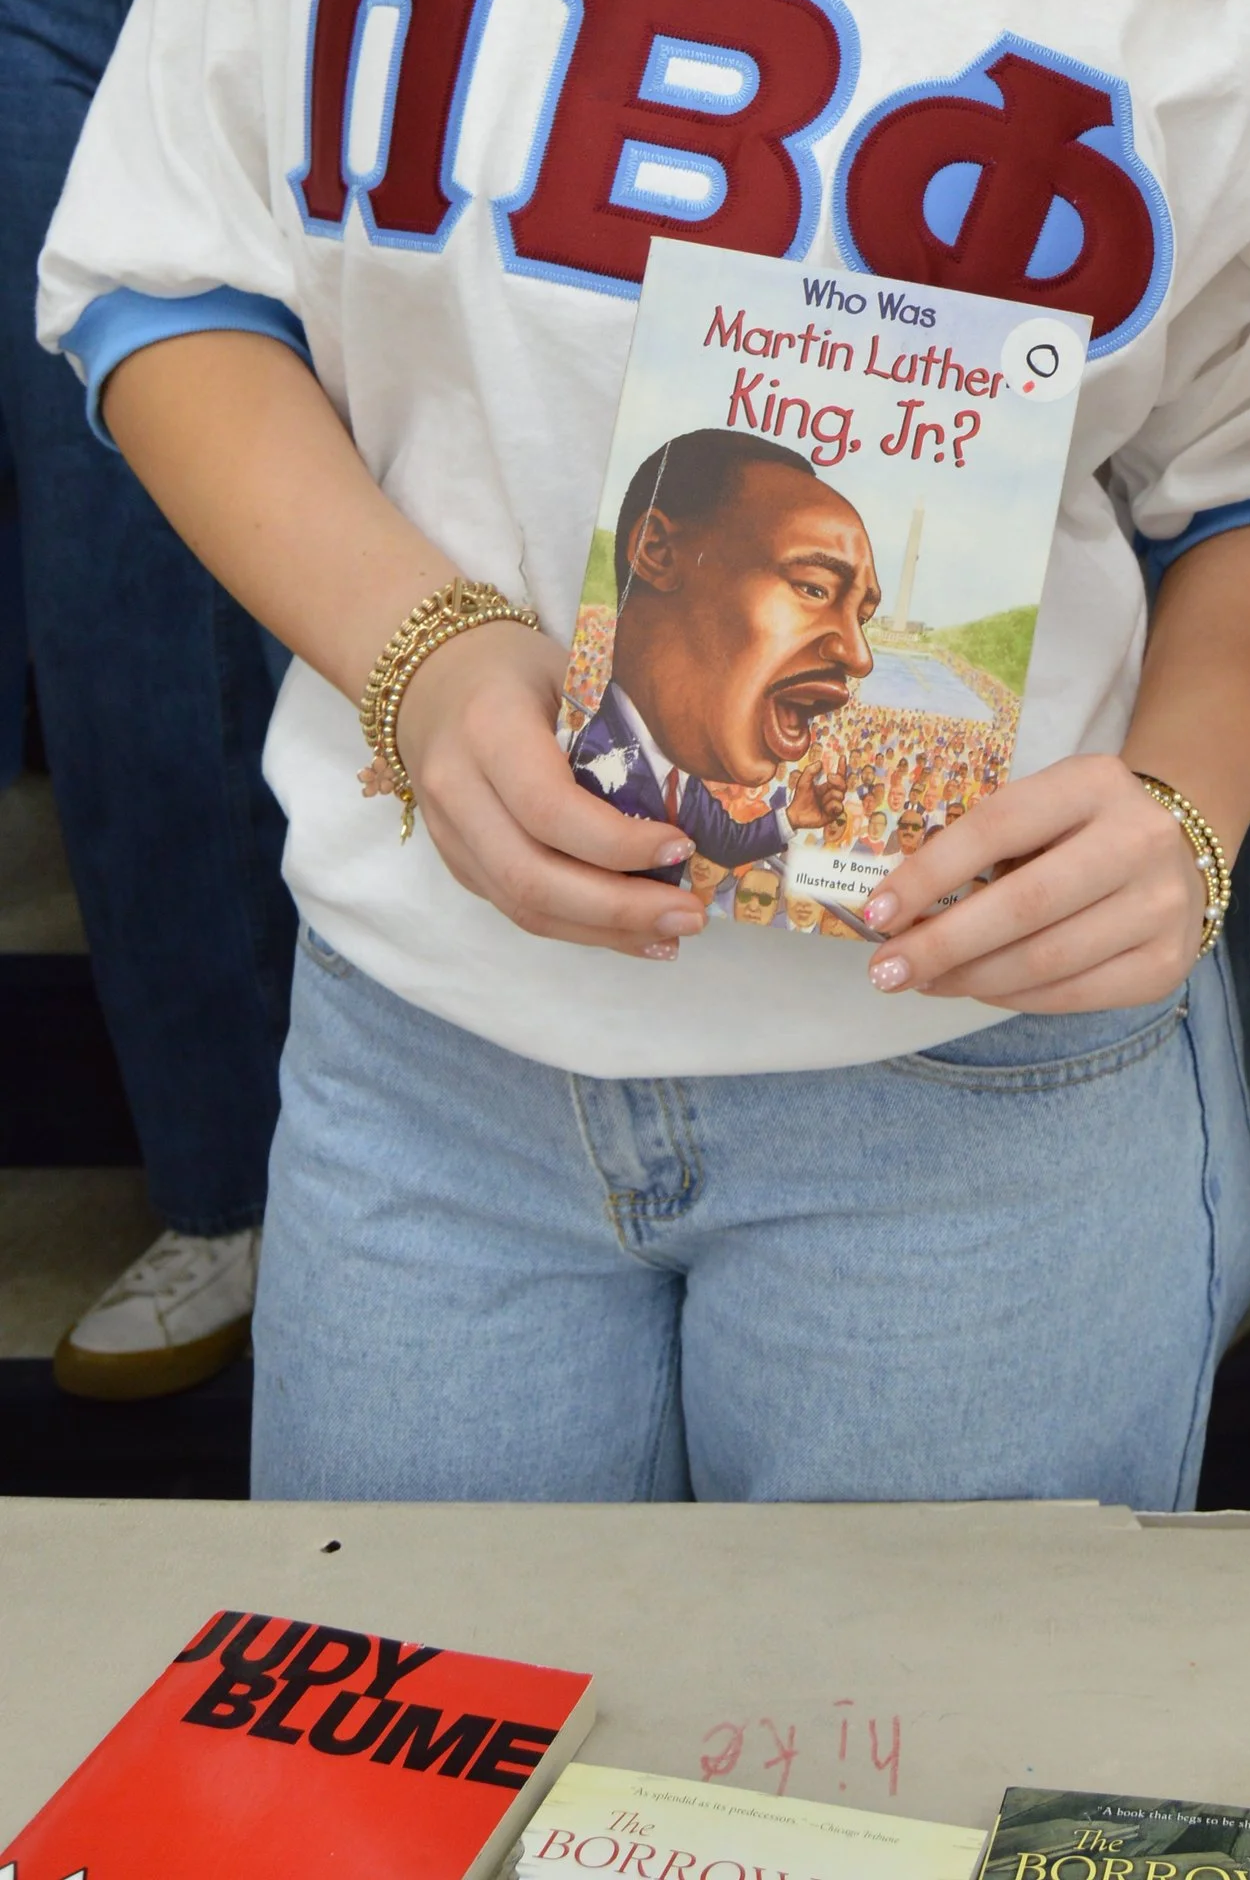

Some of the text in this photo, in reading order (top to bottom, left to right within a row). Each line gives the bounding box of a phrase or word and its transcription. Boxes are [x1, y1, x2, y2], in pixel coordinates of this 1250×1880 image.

[803, 277, 937, 328] Who Was
[703, 305, 1008, 399] Martin Luther
[726, 367, 982, 468] King, Jr.?
[832, 858, 890, 877] By Bonnie
[796, 873, 855, 893] Illustrated
[859, 885, 874, 897] by
[173, 1609, 447, 1699] JUDY
[179, 1670, 559, 1791] BLUME
[651, 1790, 698, 1807] splendid
[698, 1800, 710, 1809] as
[713, 1803, 726, 1812] its
[604, 1809, 656, 1837] The
[1116, 1807, 1146, 1819] book
[1149, 1809, 1173, 1821] that
[1176, 1811, 1203, 1826] begs
[1205, 1816, 1219, 1826] to
[1222, 1817, 1236, 1828] be
[1073, 1828, 1125, 1853] The
